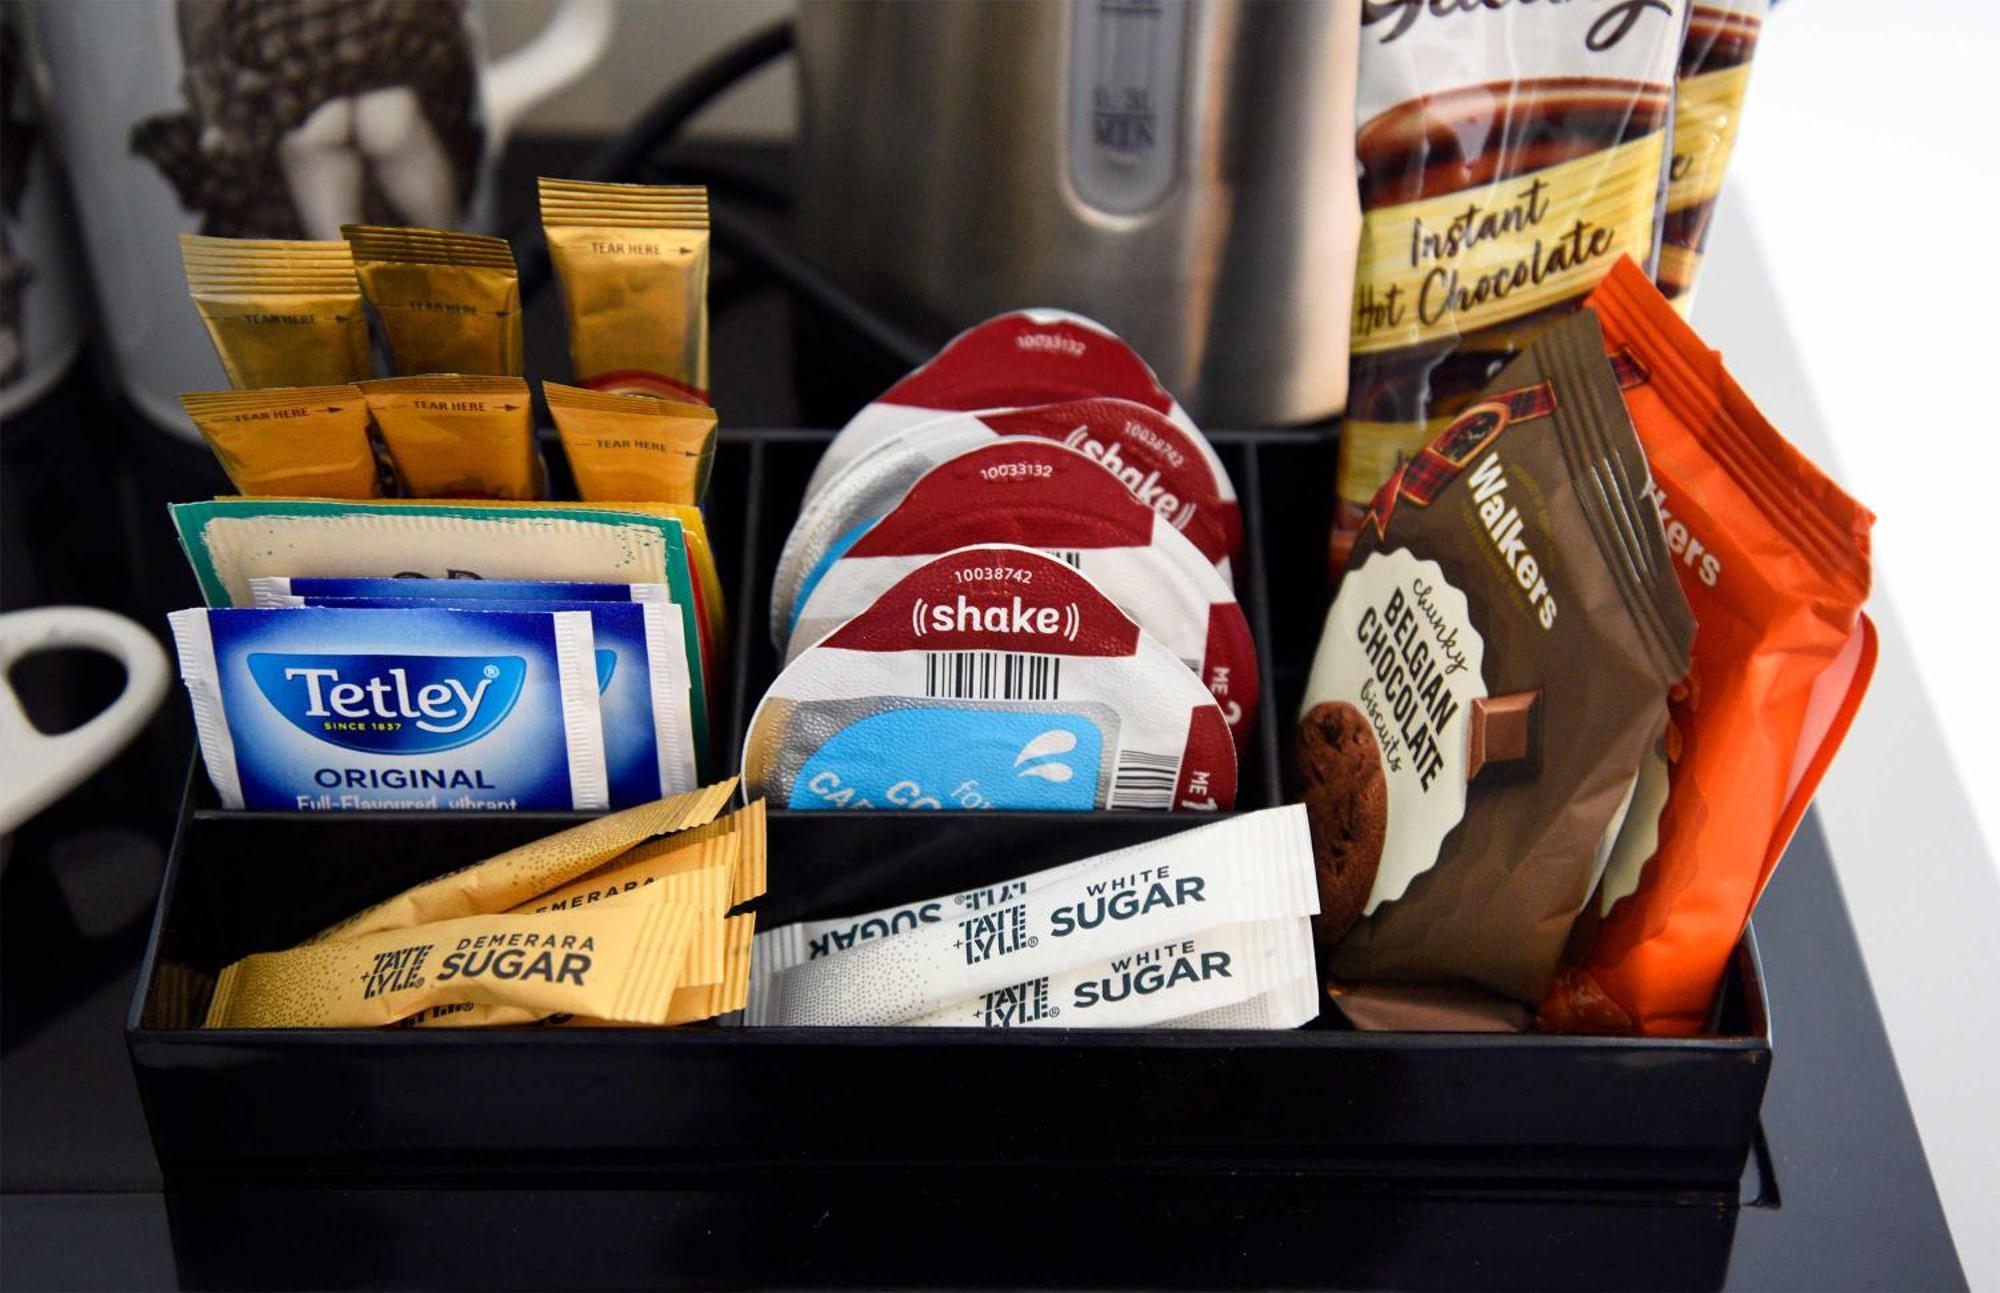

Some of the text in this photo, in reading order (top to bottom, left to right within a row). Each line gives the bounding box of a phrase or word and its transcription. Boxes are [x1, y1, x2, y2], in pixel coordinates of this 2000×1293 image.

[1411, 178, 1549, 266] Instant
[592, 241, 661, 255] TEAR HERE
[1358, 219, 1614, 336] Hot Chocolate
[244, 314, 317, 324] TEAR HERE
[410, 302, 477, 315] TEAR HERE
[234, 407, 310, 422] TEAR HERE
[414, 400, 486, 412] TEAR HERE
[597, 440, 667, 452] TEAR HERE
[1124, 420, 1185, 468] 10038742
[980, 463, 1053, 480] 10033132
[1468, 452, 1557, 630] Walkers
[954, 567, 1033, 584] 10038742
[1384, 585, 1458, 736] BELGIAN
[1211, 666, 1231, 695] ME
[1357, 606, 1444, 793] CHOCOLATE
[323, 722, 402, 731] SINCE 1837
[1361, 678, 1402, 772] biscuits
[314, 768, 496, 789] ORIGINAL
[1188, 770, 1211, 796] ME
[1086, 865, 1170, 897] WHITE
[1050, 876, 1206, 937] SUGAR
[958, 904, 1027, 942] TATE
[456, 933, 595, 952] DEMERARA
[1111, 940, 1195, 974] WHITE
[373, 944, 434, 974] TATE
[436, 949, 592, 986] SUGAR
[979, 976, 1049, 1011] TATE
[1073, 951, 1232, 1008] SUGAR
